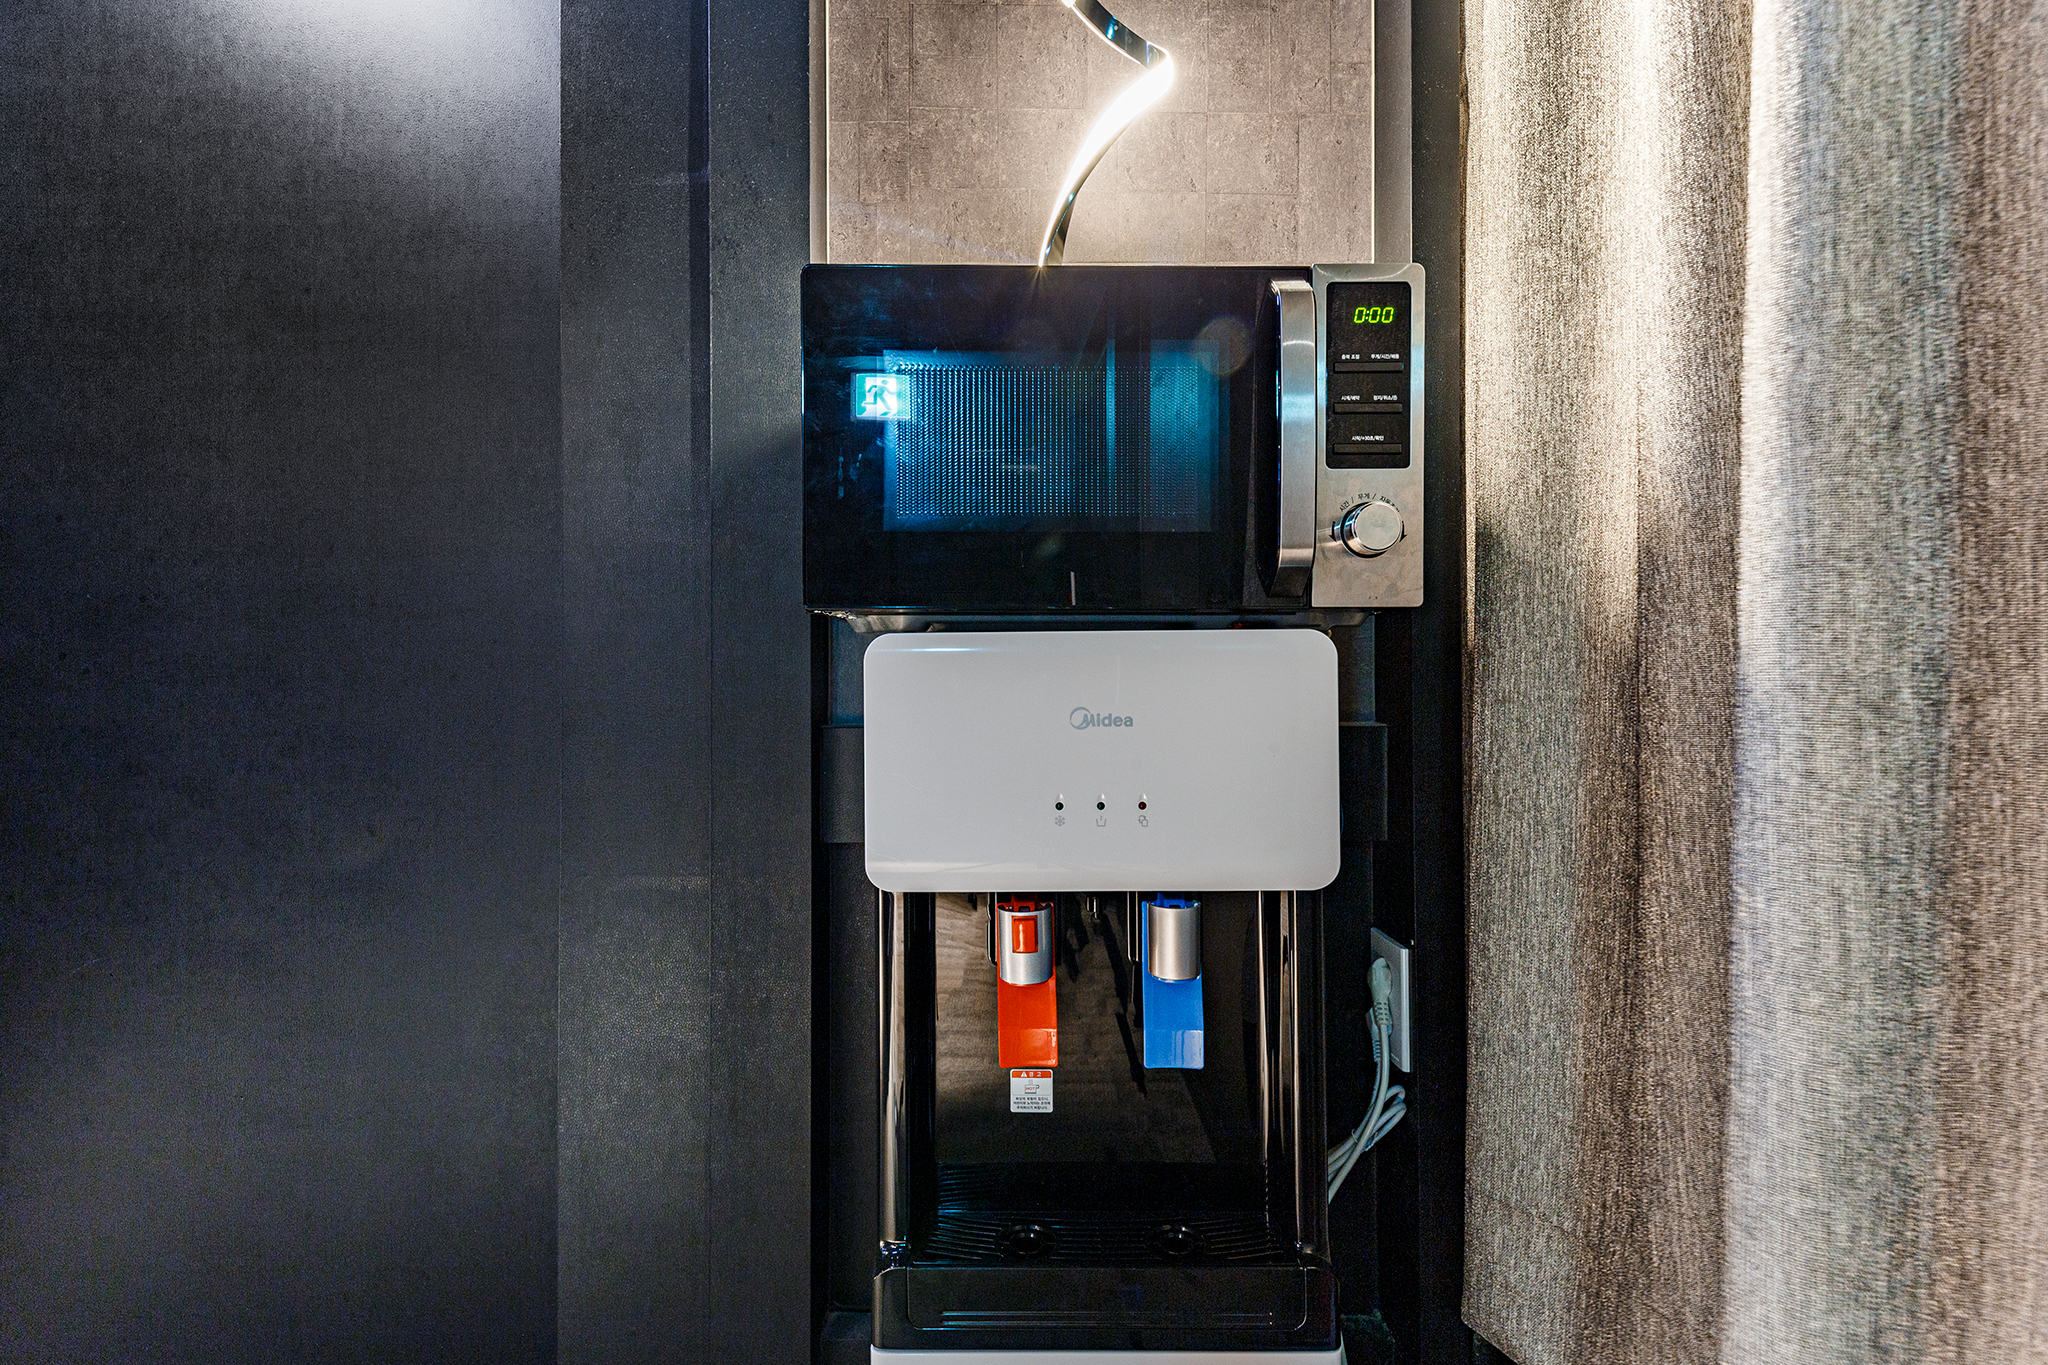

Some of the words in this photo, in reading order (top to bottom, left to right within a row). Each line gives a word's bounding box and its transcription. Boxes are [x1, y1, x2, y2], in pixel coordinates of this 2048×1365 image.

[1353, 306, 1395, 324] 0:00
[1339, 500, 1351, 512] 시간
[1357, 492, 1370, 500] 무게
[1069, 706, 1134, 731] Midea
